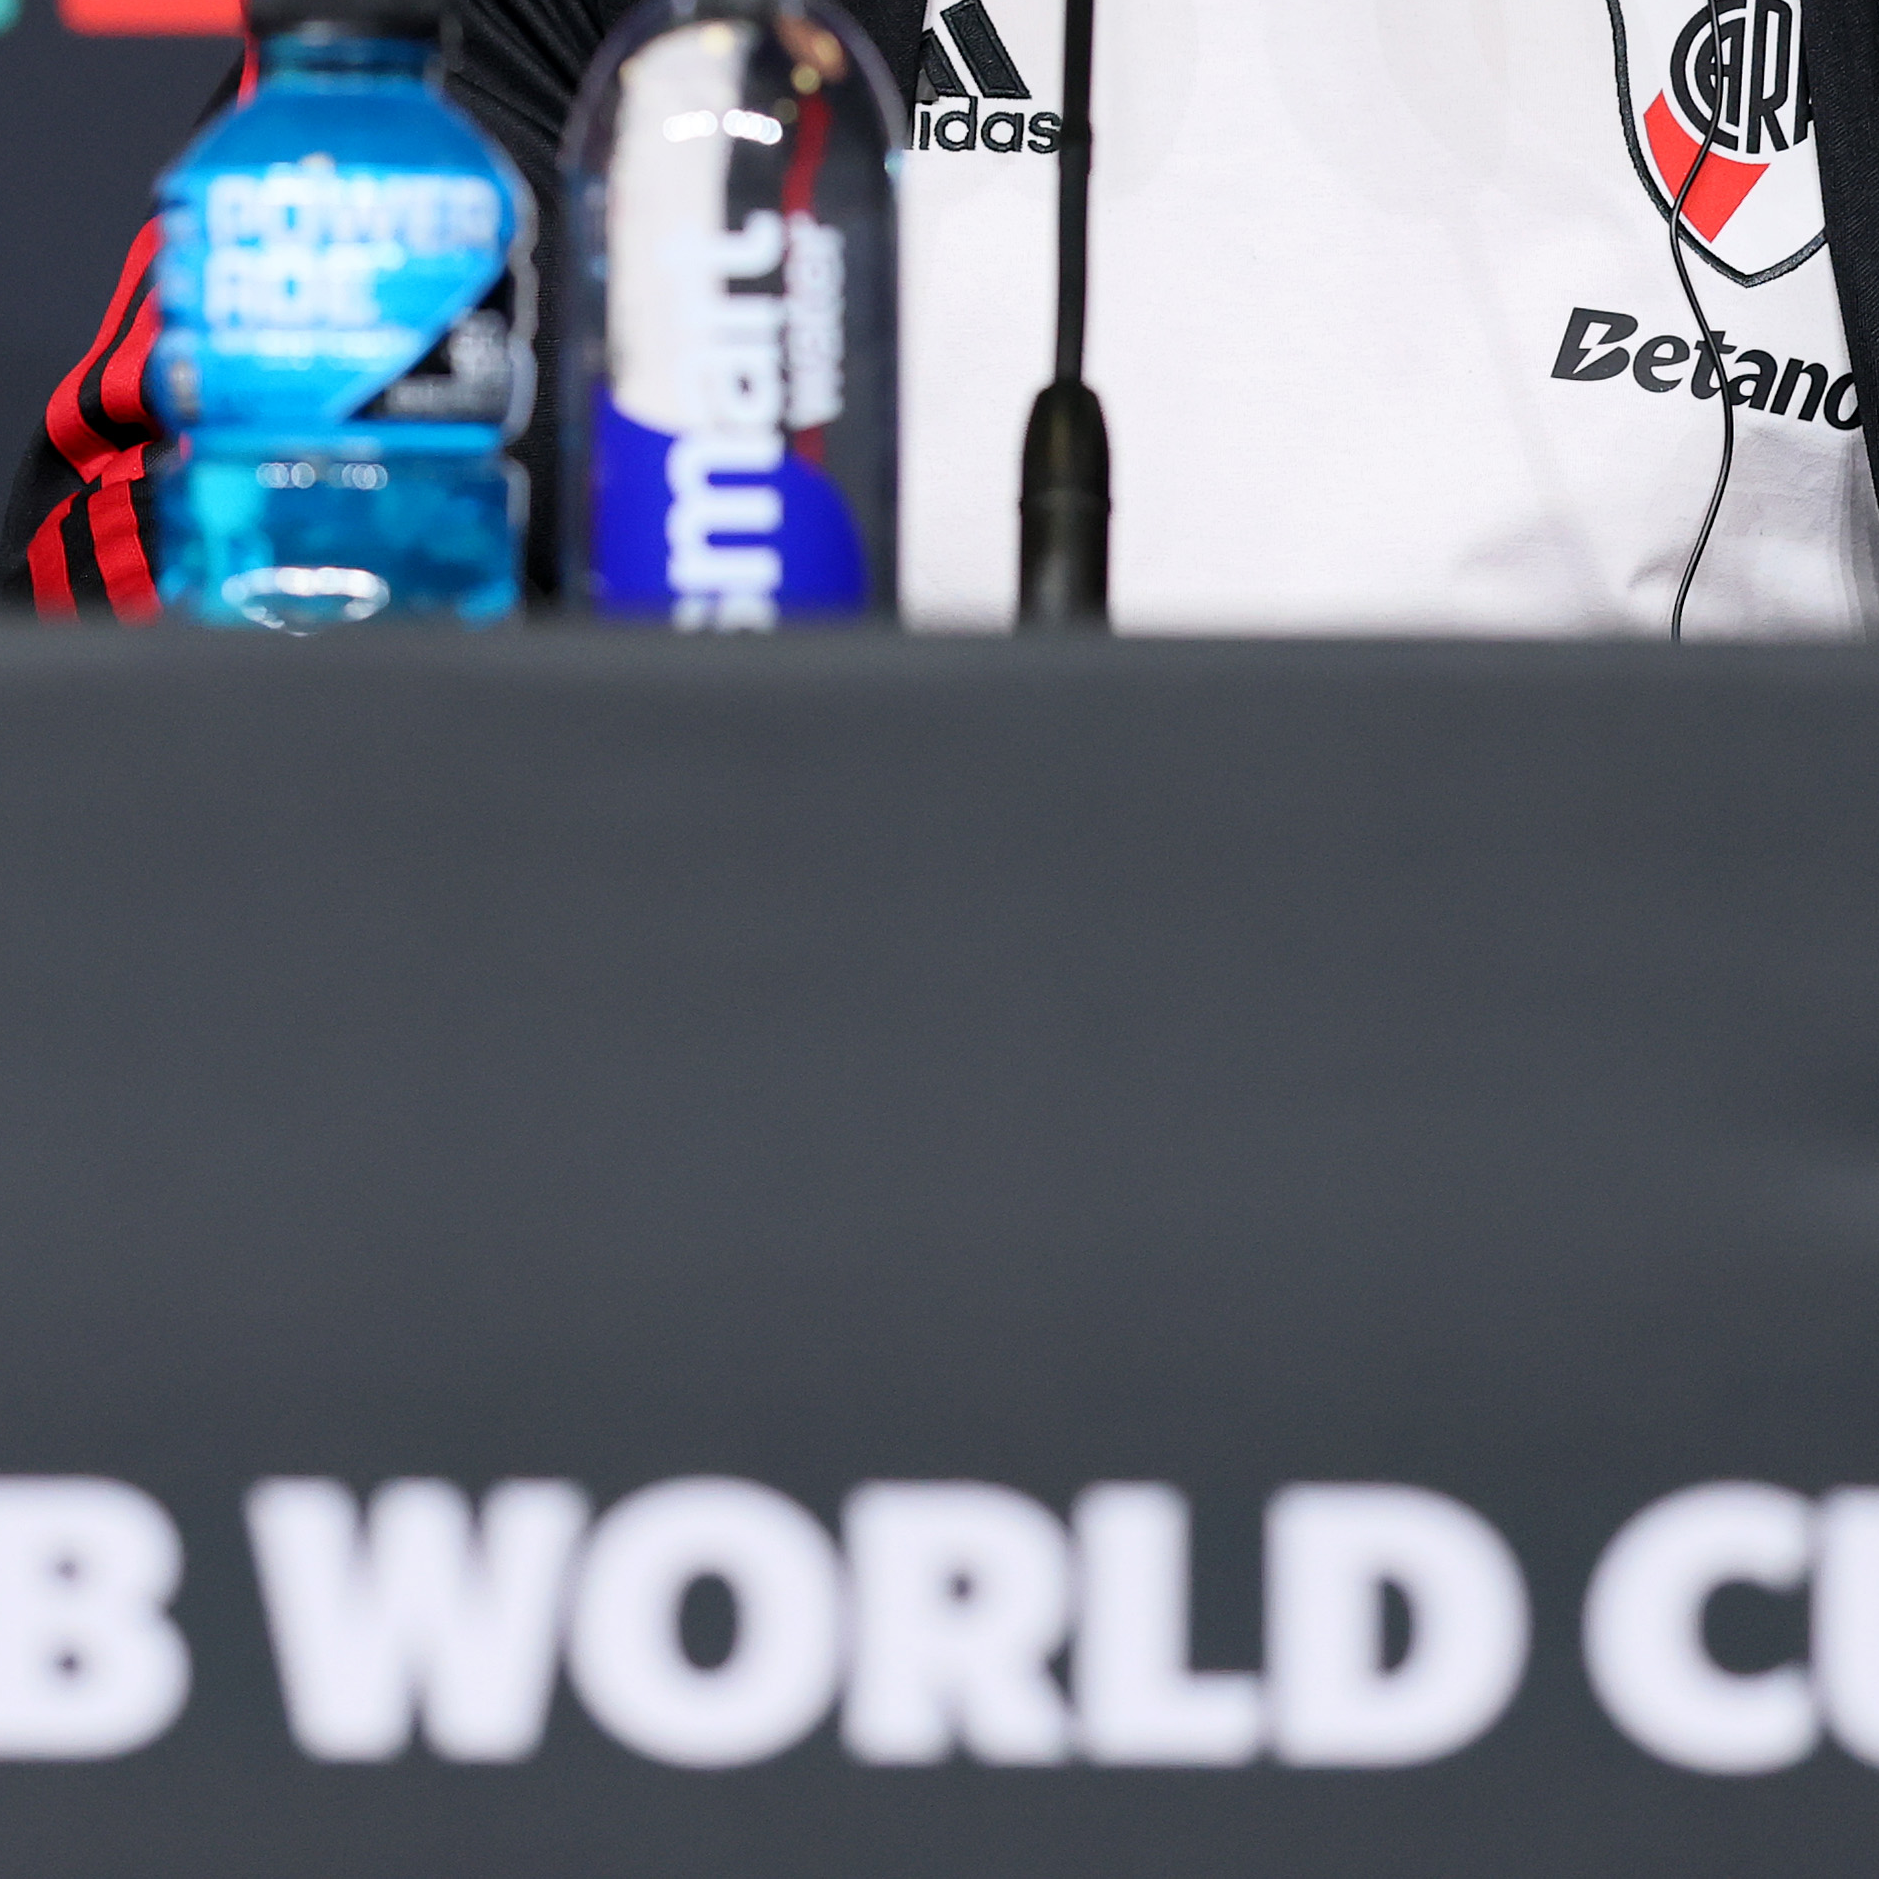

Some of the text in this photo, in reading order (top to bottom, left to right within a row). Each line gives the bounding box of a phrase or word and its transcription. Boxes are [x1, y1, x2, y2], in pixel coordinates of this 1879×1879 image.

[906, 95, 1064, 154] idas
[1551, 306, 1863, 431] Betano
[248, 1478, 1528, 1767] WORLD
